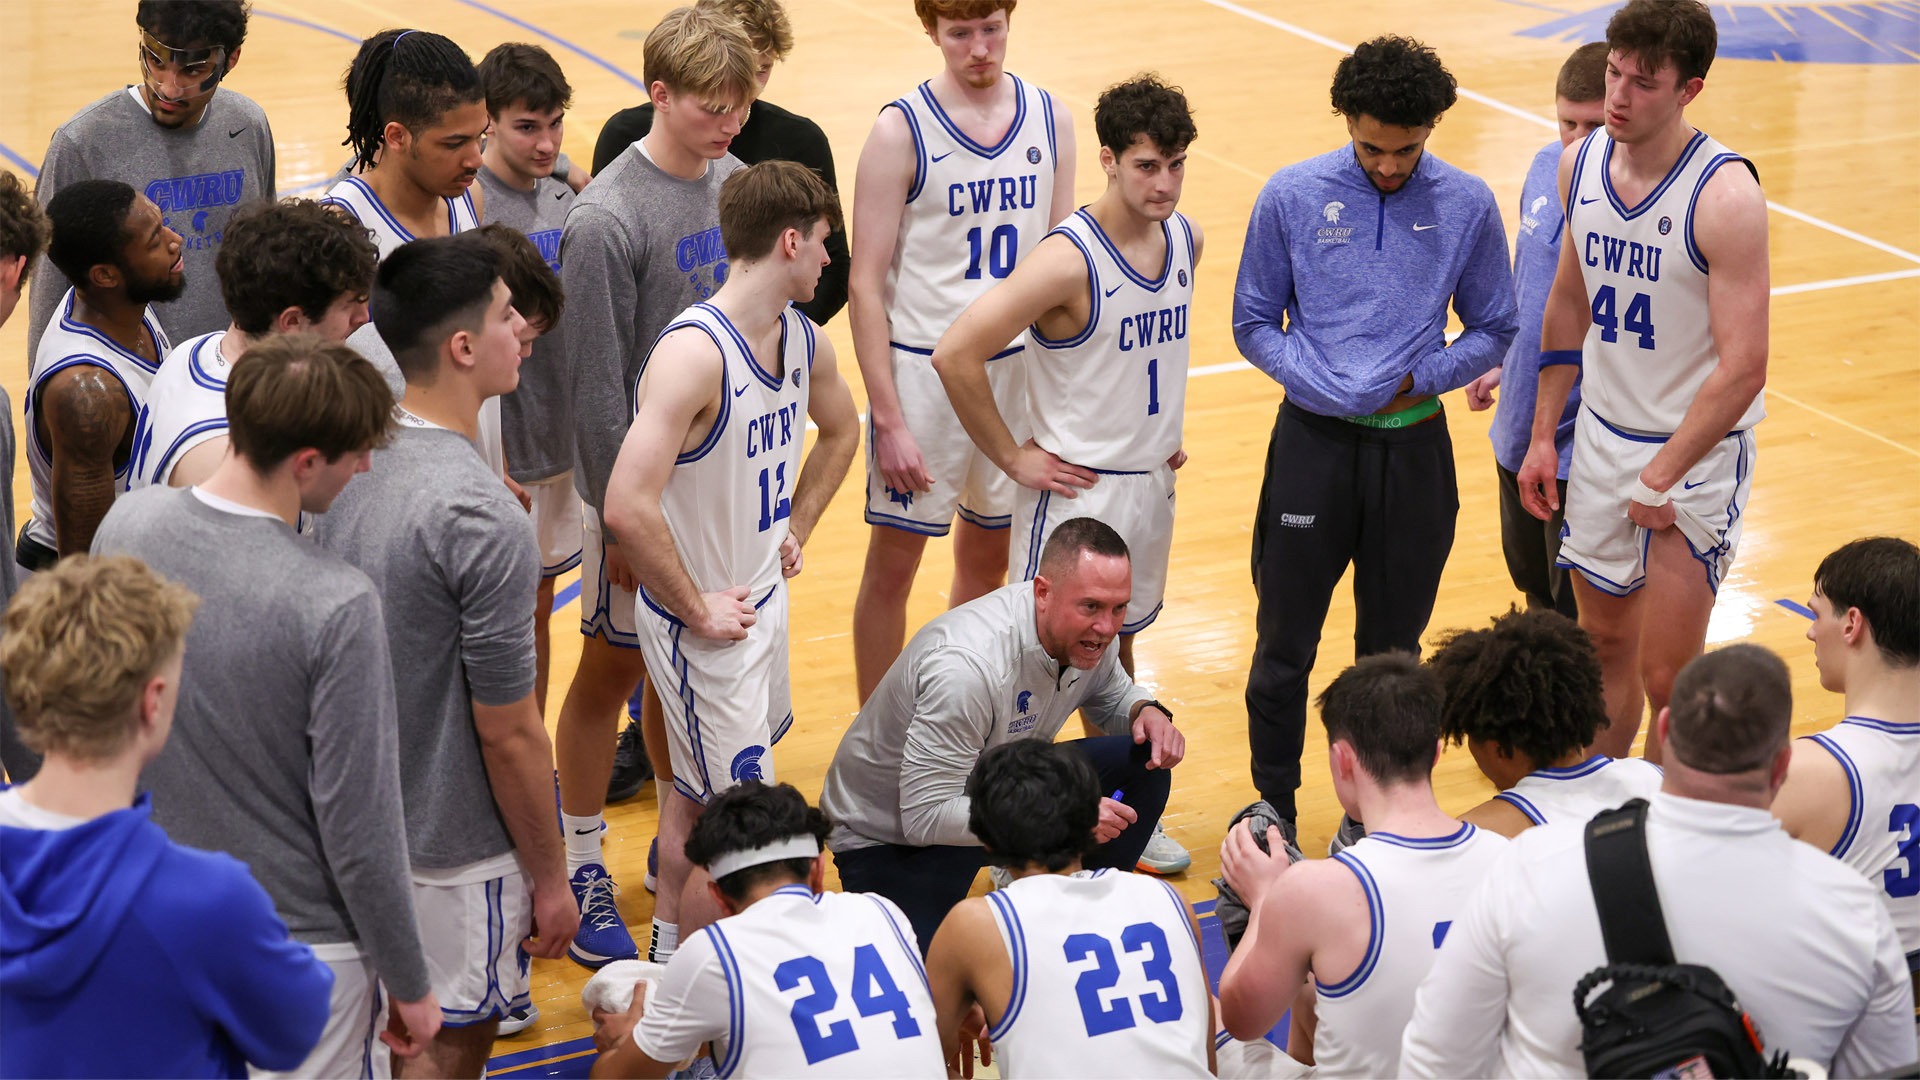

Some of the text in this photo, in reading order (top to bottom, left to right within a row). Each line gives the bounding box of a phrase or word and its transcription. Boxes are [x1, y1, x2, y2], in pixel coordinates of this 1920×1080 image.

[144, 168, 245, 213] CWRU
[948, 174, 1038, 217] CWRU
[964, 223, 1019, 280] 10
[1585, 231, 1663, 283] CWRU
[1119, 303, 1188, 352] CWRU
[1591, 283, 1656, 351] 44
[1147, 358, 1160, 416] 1
[758, 460, 791, 533] 12
[1281, 512, 1316, 525] CWRU
[773, 943, 922, 1066] 24
[1063, 921, 1182, 1038] 23
